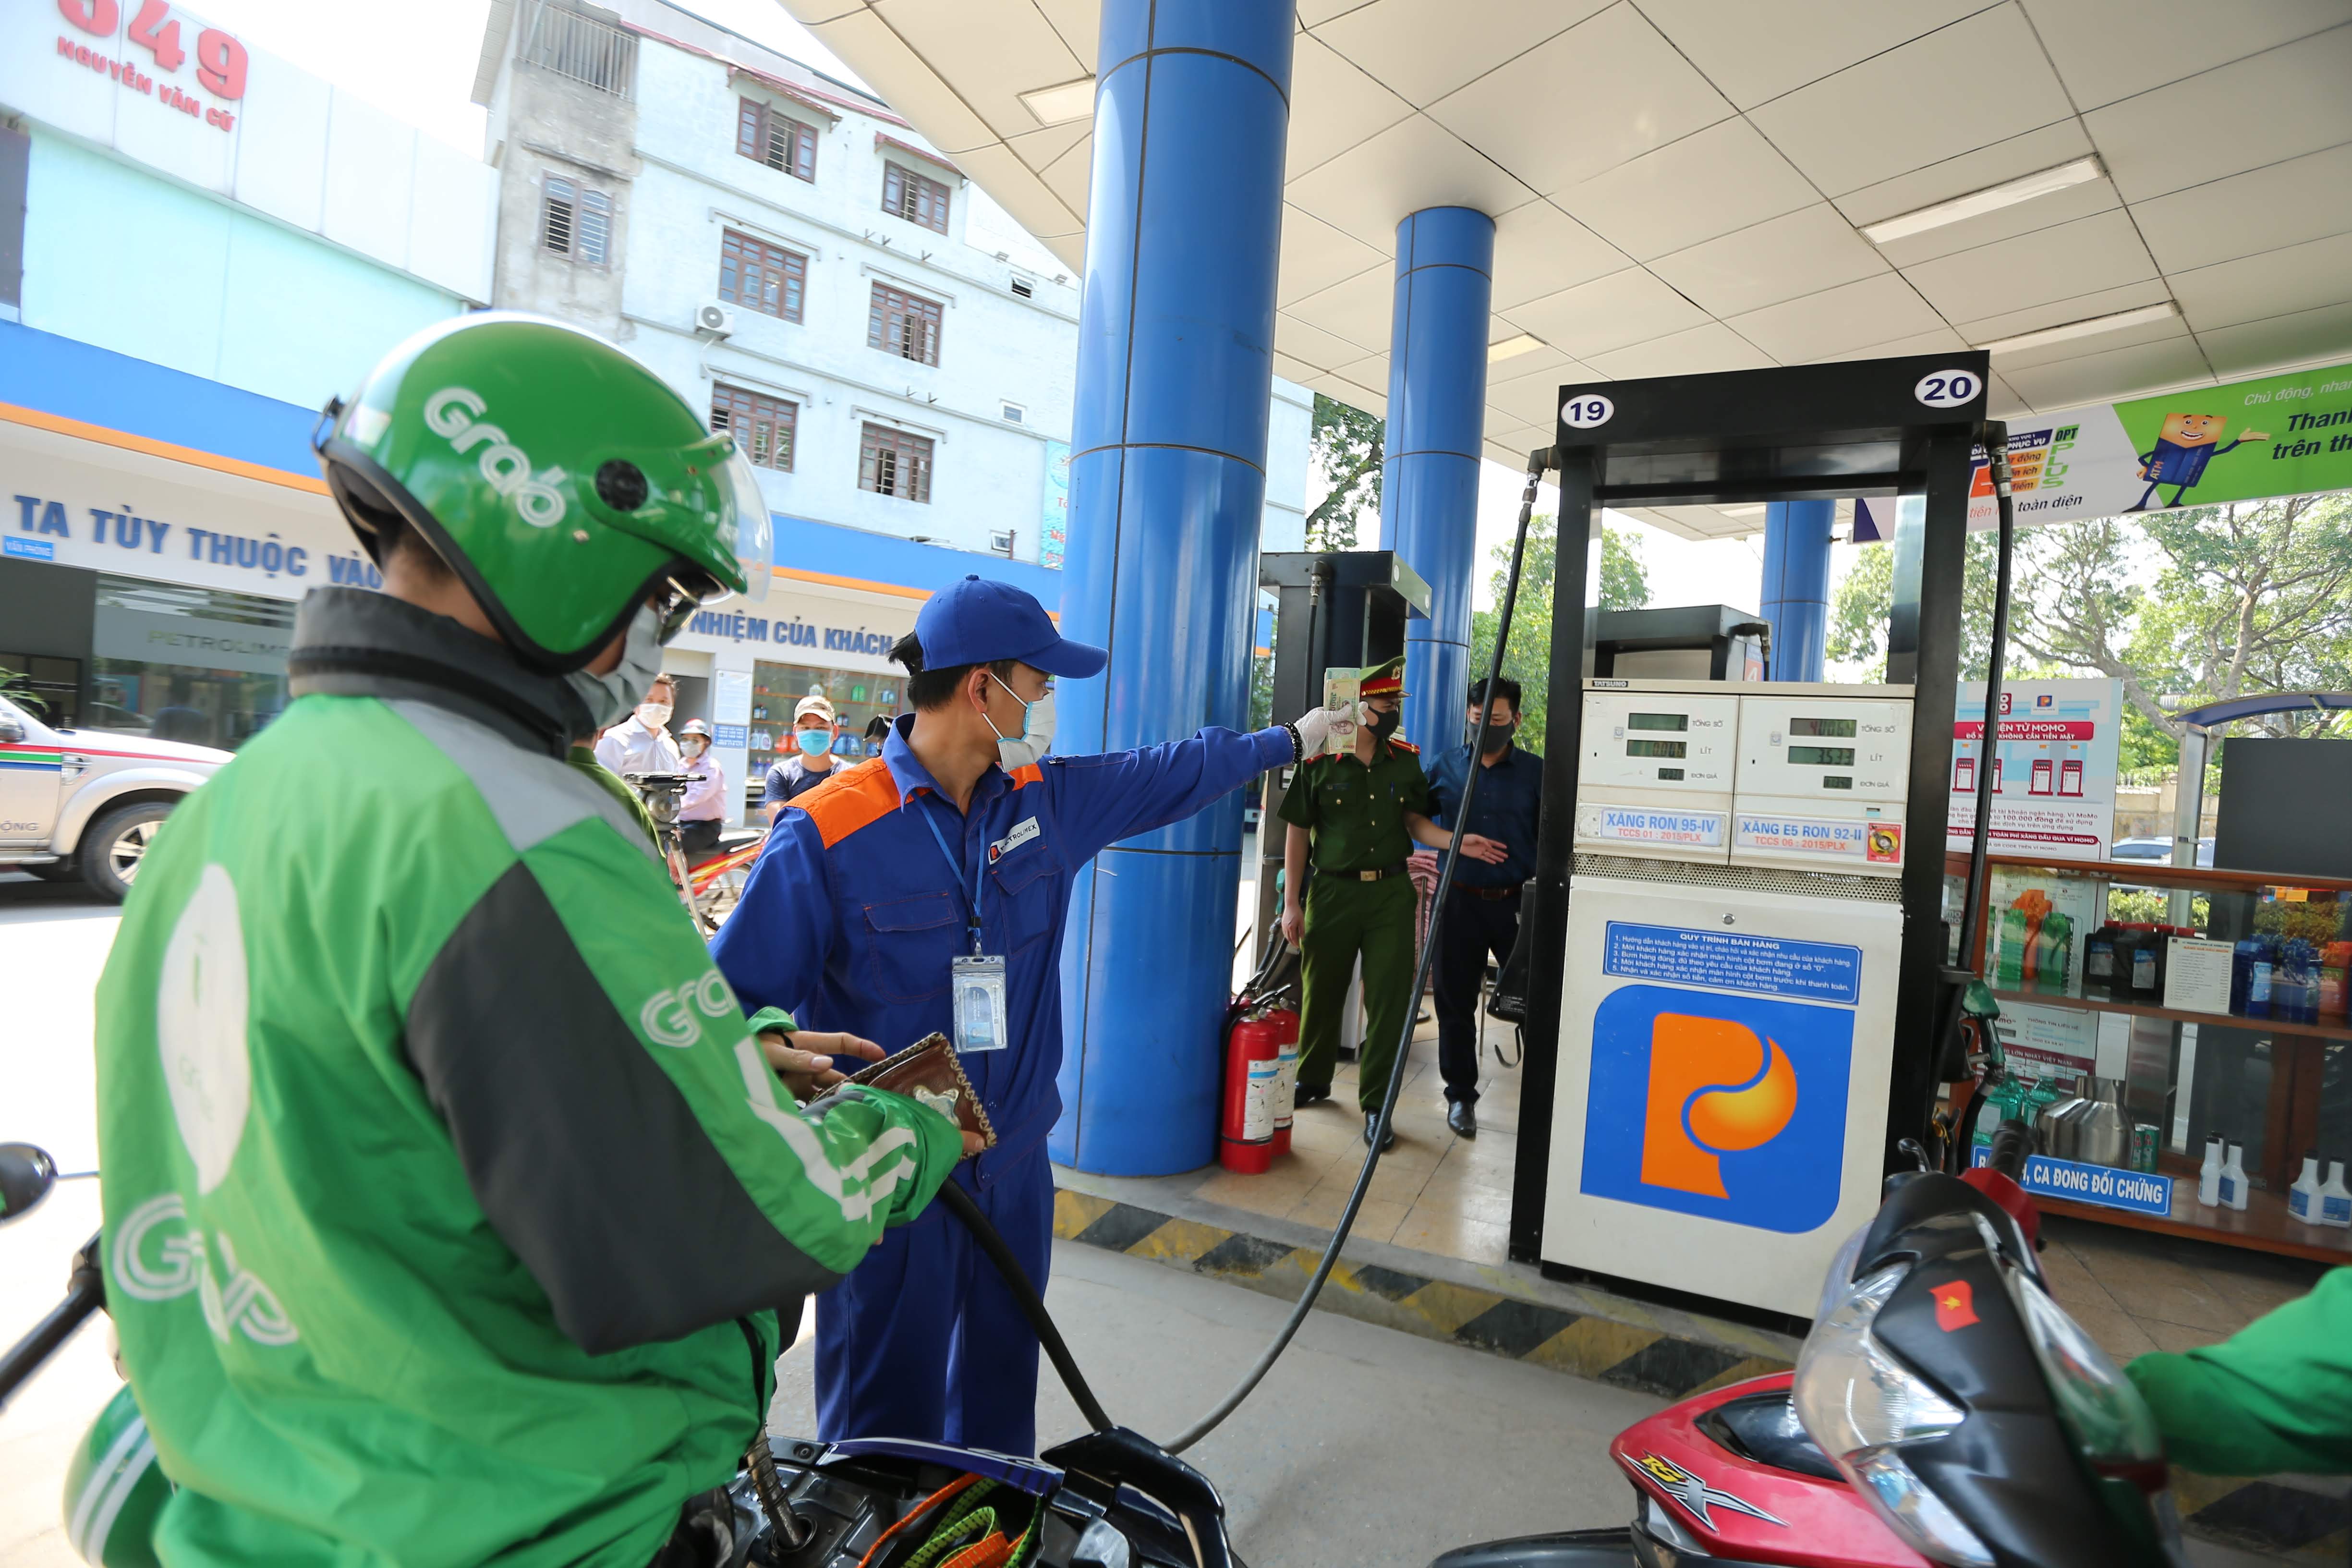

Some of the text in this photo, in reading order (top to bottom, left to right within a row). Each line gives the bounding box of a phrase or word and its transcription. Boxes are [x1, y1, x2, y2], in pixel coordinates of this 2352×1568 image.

[58, 36, 152, 95] NGUYỄN
[159, 86, 200, 117] VĂN
[1923, 377, 1972, 401] 20
[2244, 391, 2271, 406] Chủ
[2276, 386, 2314, 402] động,
[1569, 401, 1605, 421] 19
[2007, 438, 2046, 450] PHỤC VỤ
[2055, 427, 2078, 441] OPT
[424, 387, 568, 528] Grab
[2017, 452, 2041, 463] động
[2273, 435, 2322, 460] trên
[2023, 467, 2037, 475] ích
[2150, 461, 2164, 480] ATM
[1970, 506, 1991, 518] tiện
[2019, 499, 2048, 512] toàn
[2052, 494, 2082, 509] diện
[14, 495, 70, 538] TA
[90, 504, 170, 554] TÙY
[187, 532, 307, 578] THUỘC
[689, 609, 768, 643] NHIỆM
[774, 615, 817, 647] CỦA
[824, 626, 893, 656] KHÁCH
[1999, 731, 2024, 740] KHÔNG
[2016, 722, 2066, 732] TỬ MOMO
[1607, 812, 1715, 833] XĂNG RON 95-IV
[1743, 820, 1862, 840] XĂNG E5 RON 92-II
[1618, 828, 1701, 842] TCCS 01 2015/PLX
[1755, 836, 1845, 851] TCCS 06 2015/PLX
[1673, 941, 1686, 950] hàng
[1680, 933, 1780, 949] QUY TRÌNH BÁN HÀNG
[1639, 953, 1656, 961] hàng
[1658, 948, 1675, 956] hàng
[1744, 958, 1754, 966] cột
[1775, 961, 1793, 970] đang
[1621, 966, 1638, 974] Nhận
[1657, 962, 1674, 971] hàng
[1742, 972, 1753, 980] cột
[1808, 980, 1829, 989] thanh
[641, 970, 737, 1048] Gra
[2033, 1164, 2050, 1185] CA
[2053, 1168, 2088, 1191] ĐONG
[2091, 1169, 2112, 1195] ĐỐI
[2117, 1178, 2162, 1204] CHỨNG
